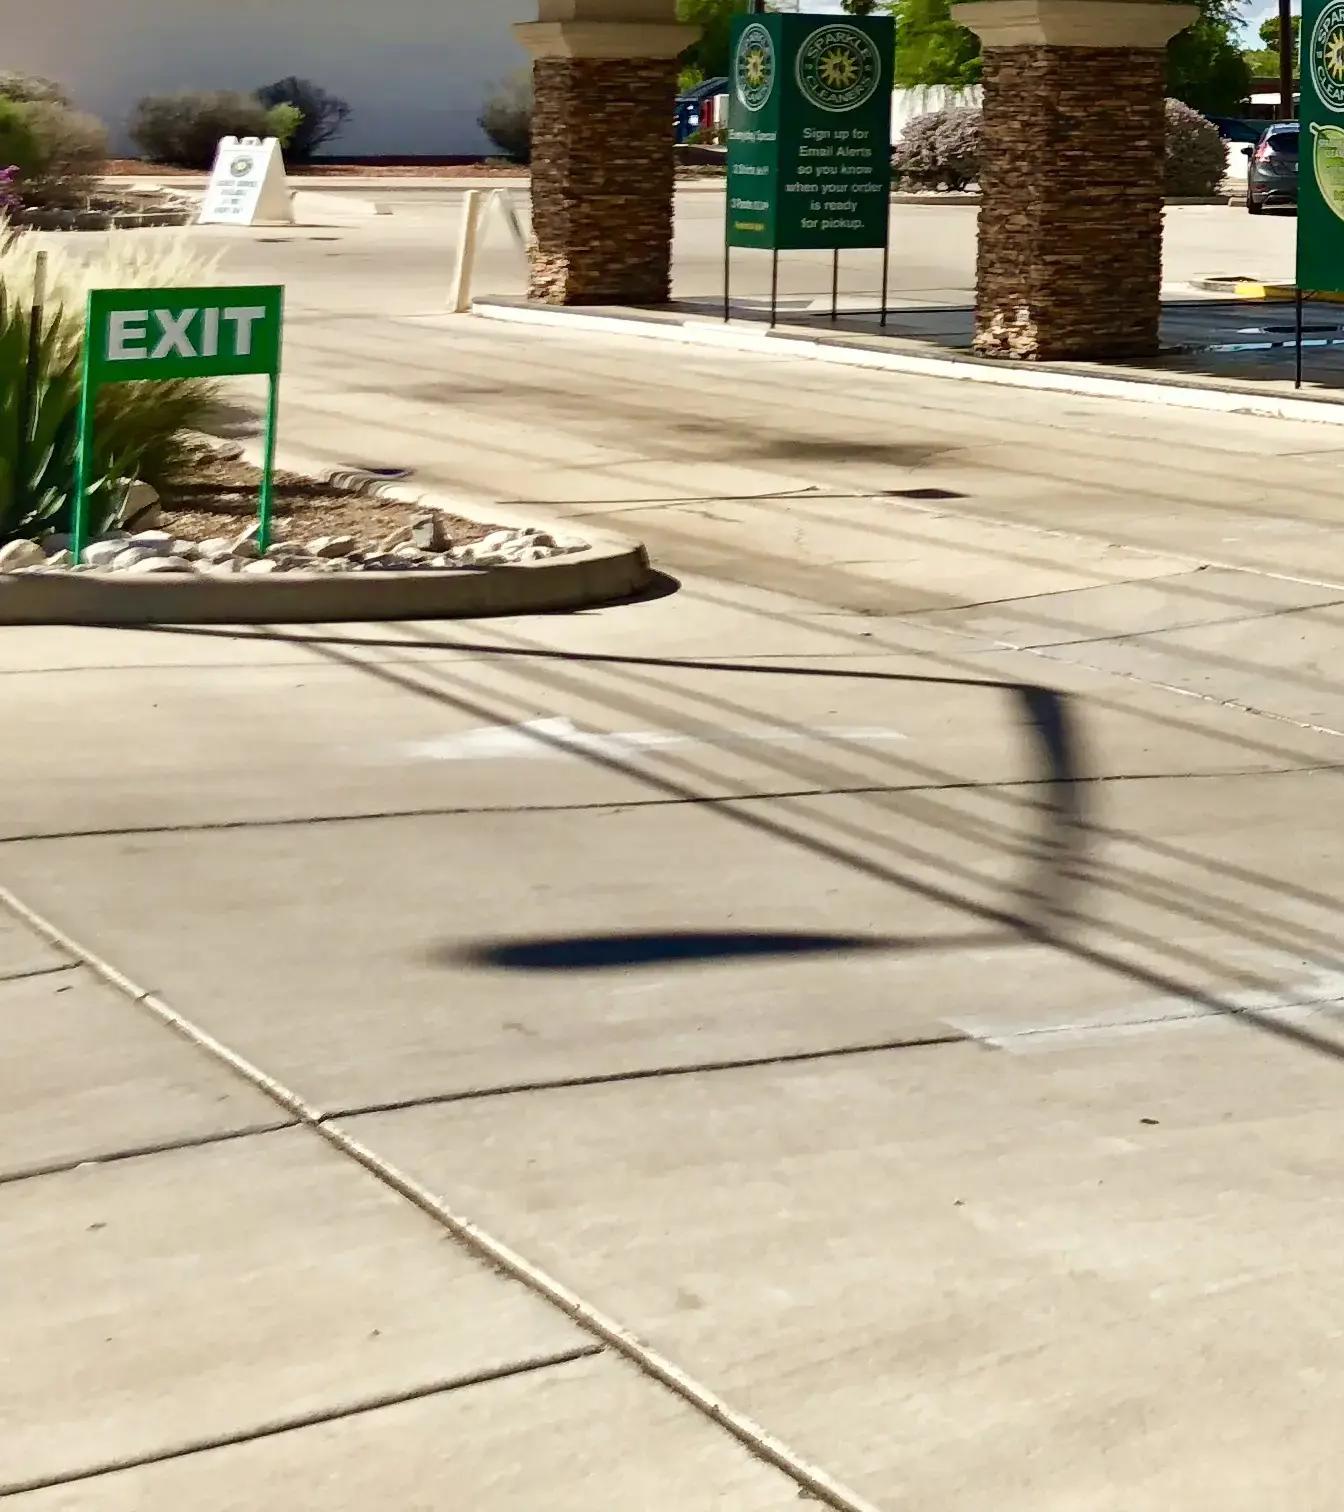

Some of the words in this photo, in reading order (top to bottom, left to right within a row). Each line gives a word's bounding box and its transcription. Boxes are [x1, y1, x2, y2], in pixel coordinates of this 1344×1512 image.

[806, 31, 873, 60] SPARKLE
[804, 75, 870, 103] CLEANERS
[803, 127, 831, 141] Sign
[834, 129, 850, 141] up
[852, 128, 870, 139] for
[798, 145, 834, 157] Email
[836, 146, 872, 157] Alerts
[797, 165, 813, 175] so
[816, 165, 838, 177] you
[840, 163, 873, 174] know
[785, 182, 819, 193] when
[821, 183, 848, 195] your
[851, 182, 883, 193] order
[810, 199, 821, 211] is
[824, 200, 859, 213] ready
[801, 217, 818, 228] for
[821, 217, 865, 230] pickup.
[107, 305, 267, 362] EXIT
